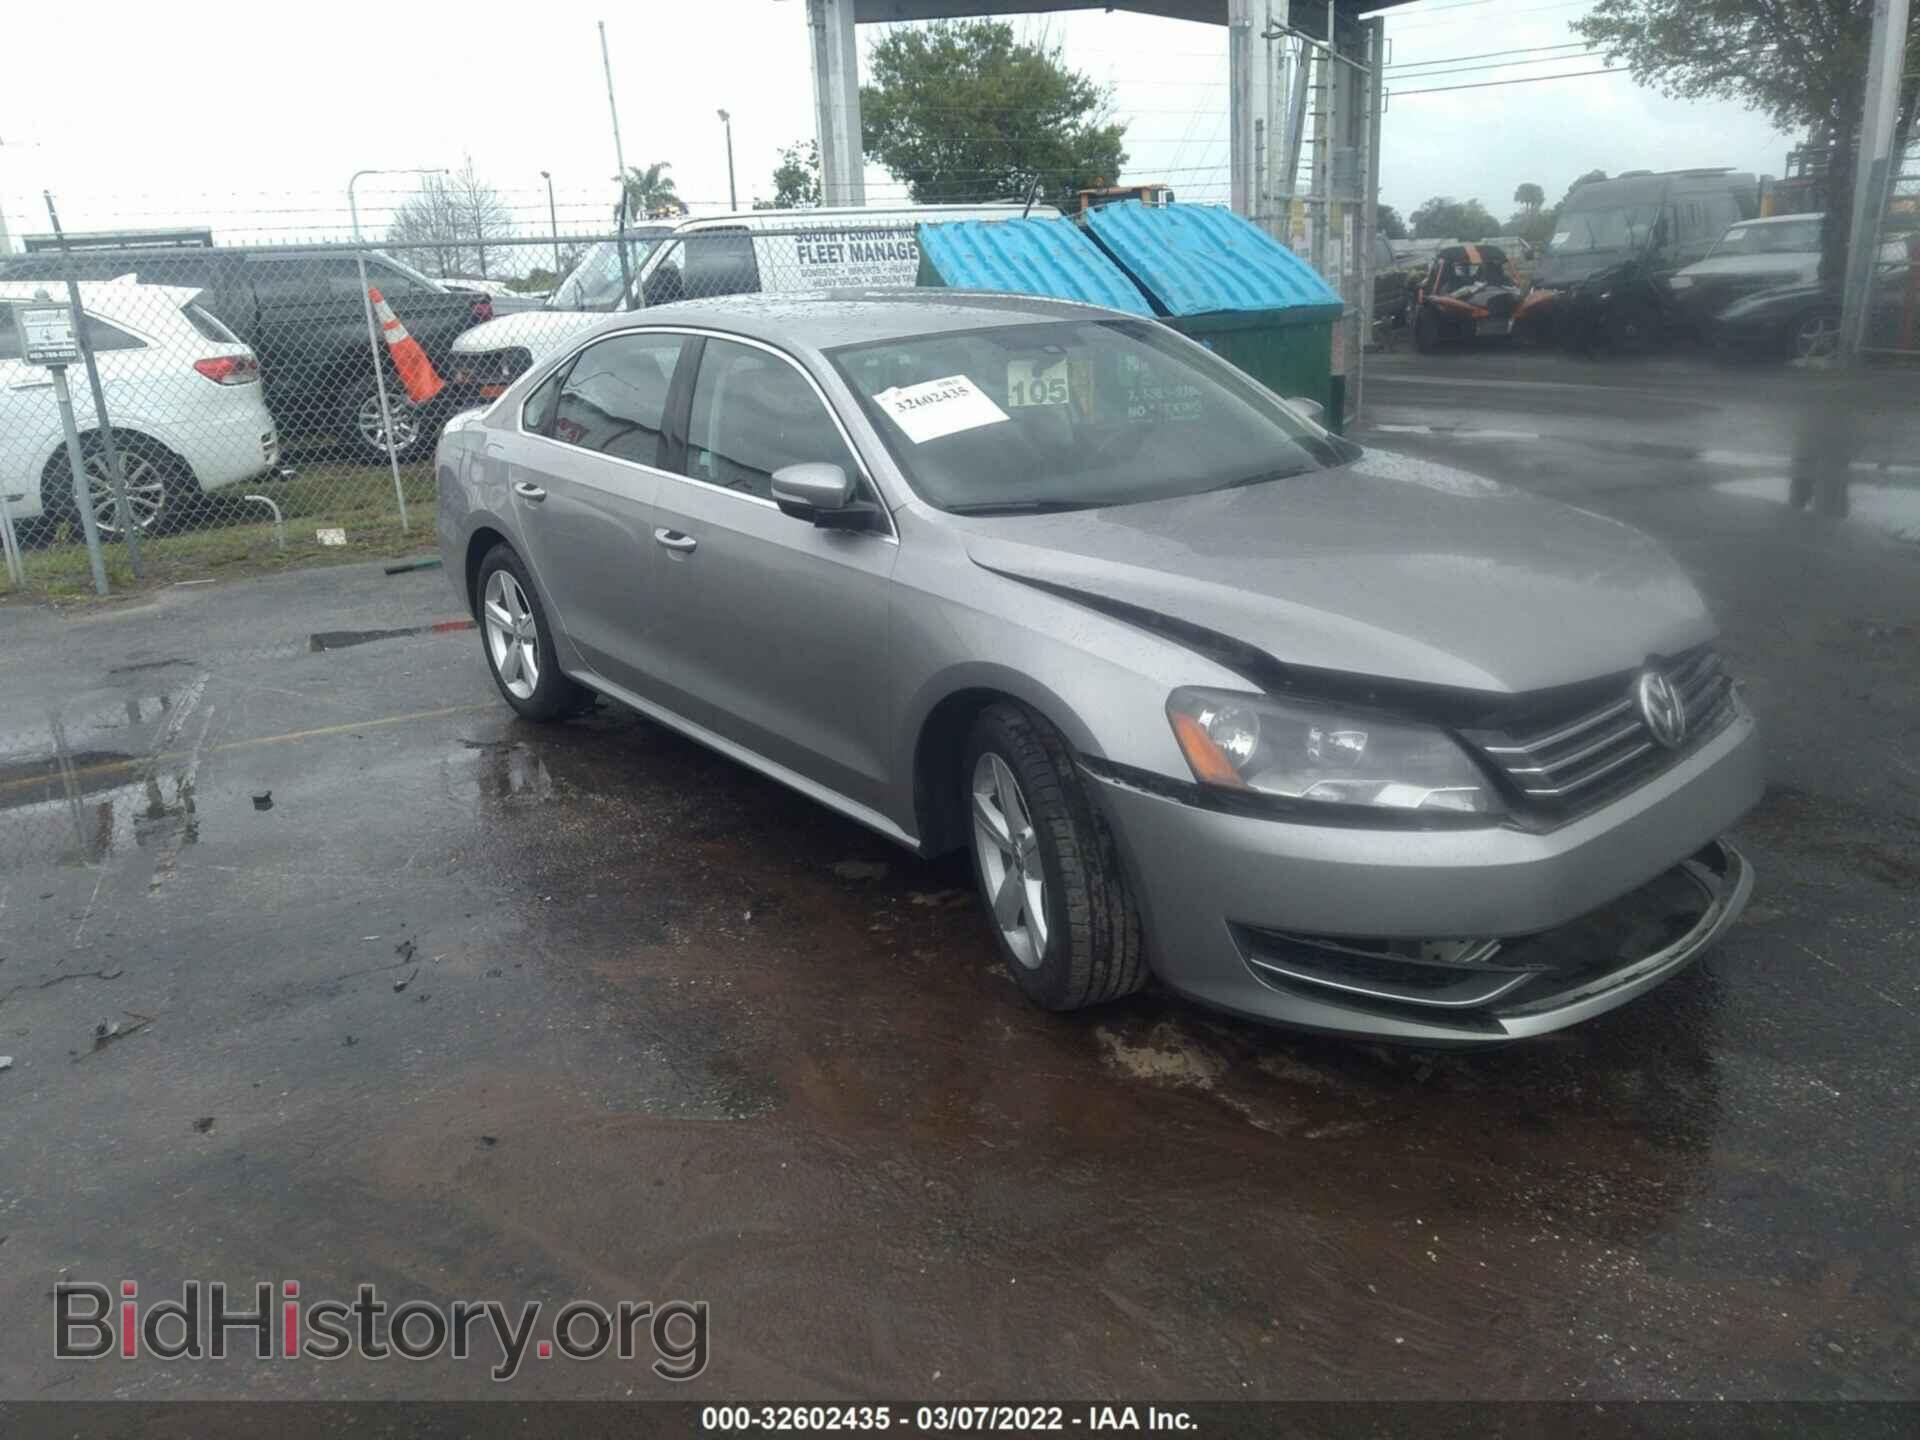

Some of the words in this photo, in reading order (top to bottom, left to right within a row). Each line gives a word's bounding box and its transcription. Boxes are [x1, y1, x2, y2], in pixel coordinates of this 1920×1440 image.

[797, 244, 845, 265] FLEET
[849, 241, 918, 262] MANAGE
[895, 385, 971, 414] 32602435
[1010, 377, 1068, 406] 105
